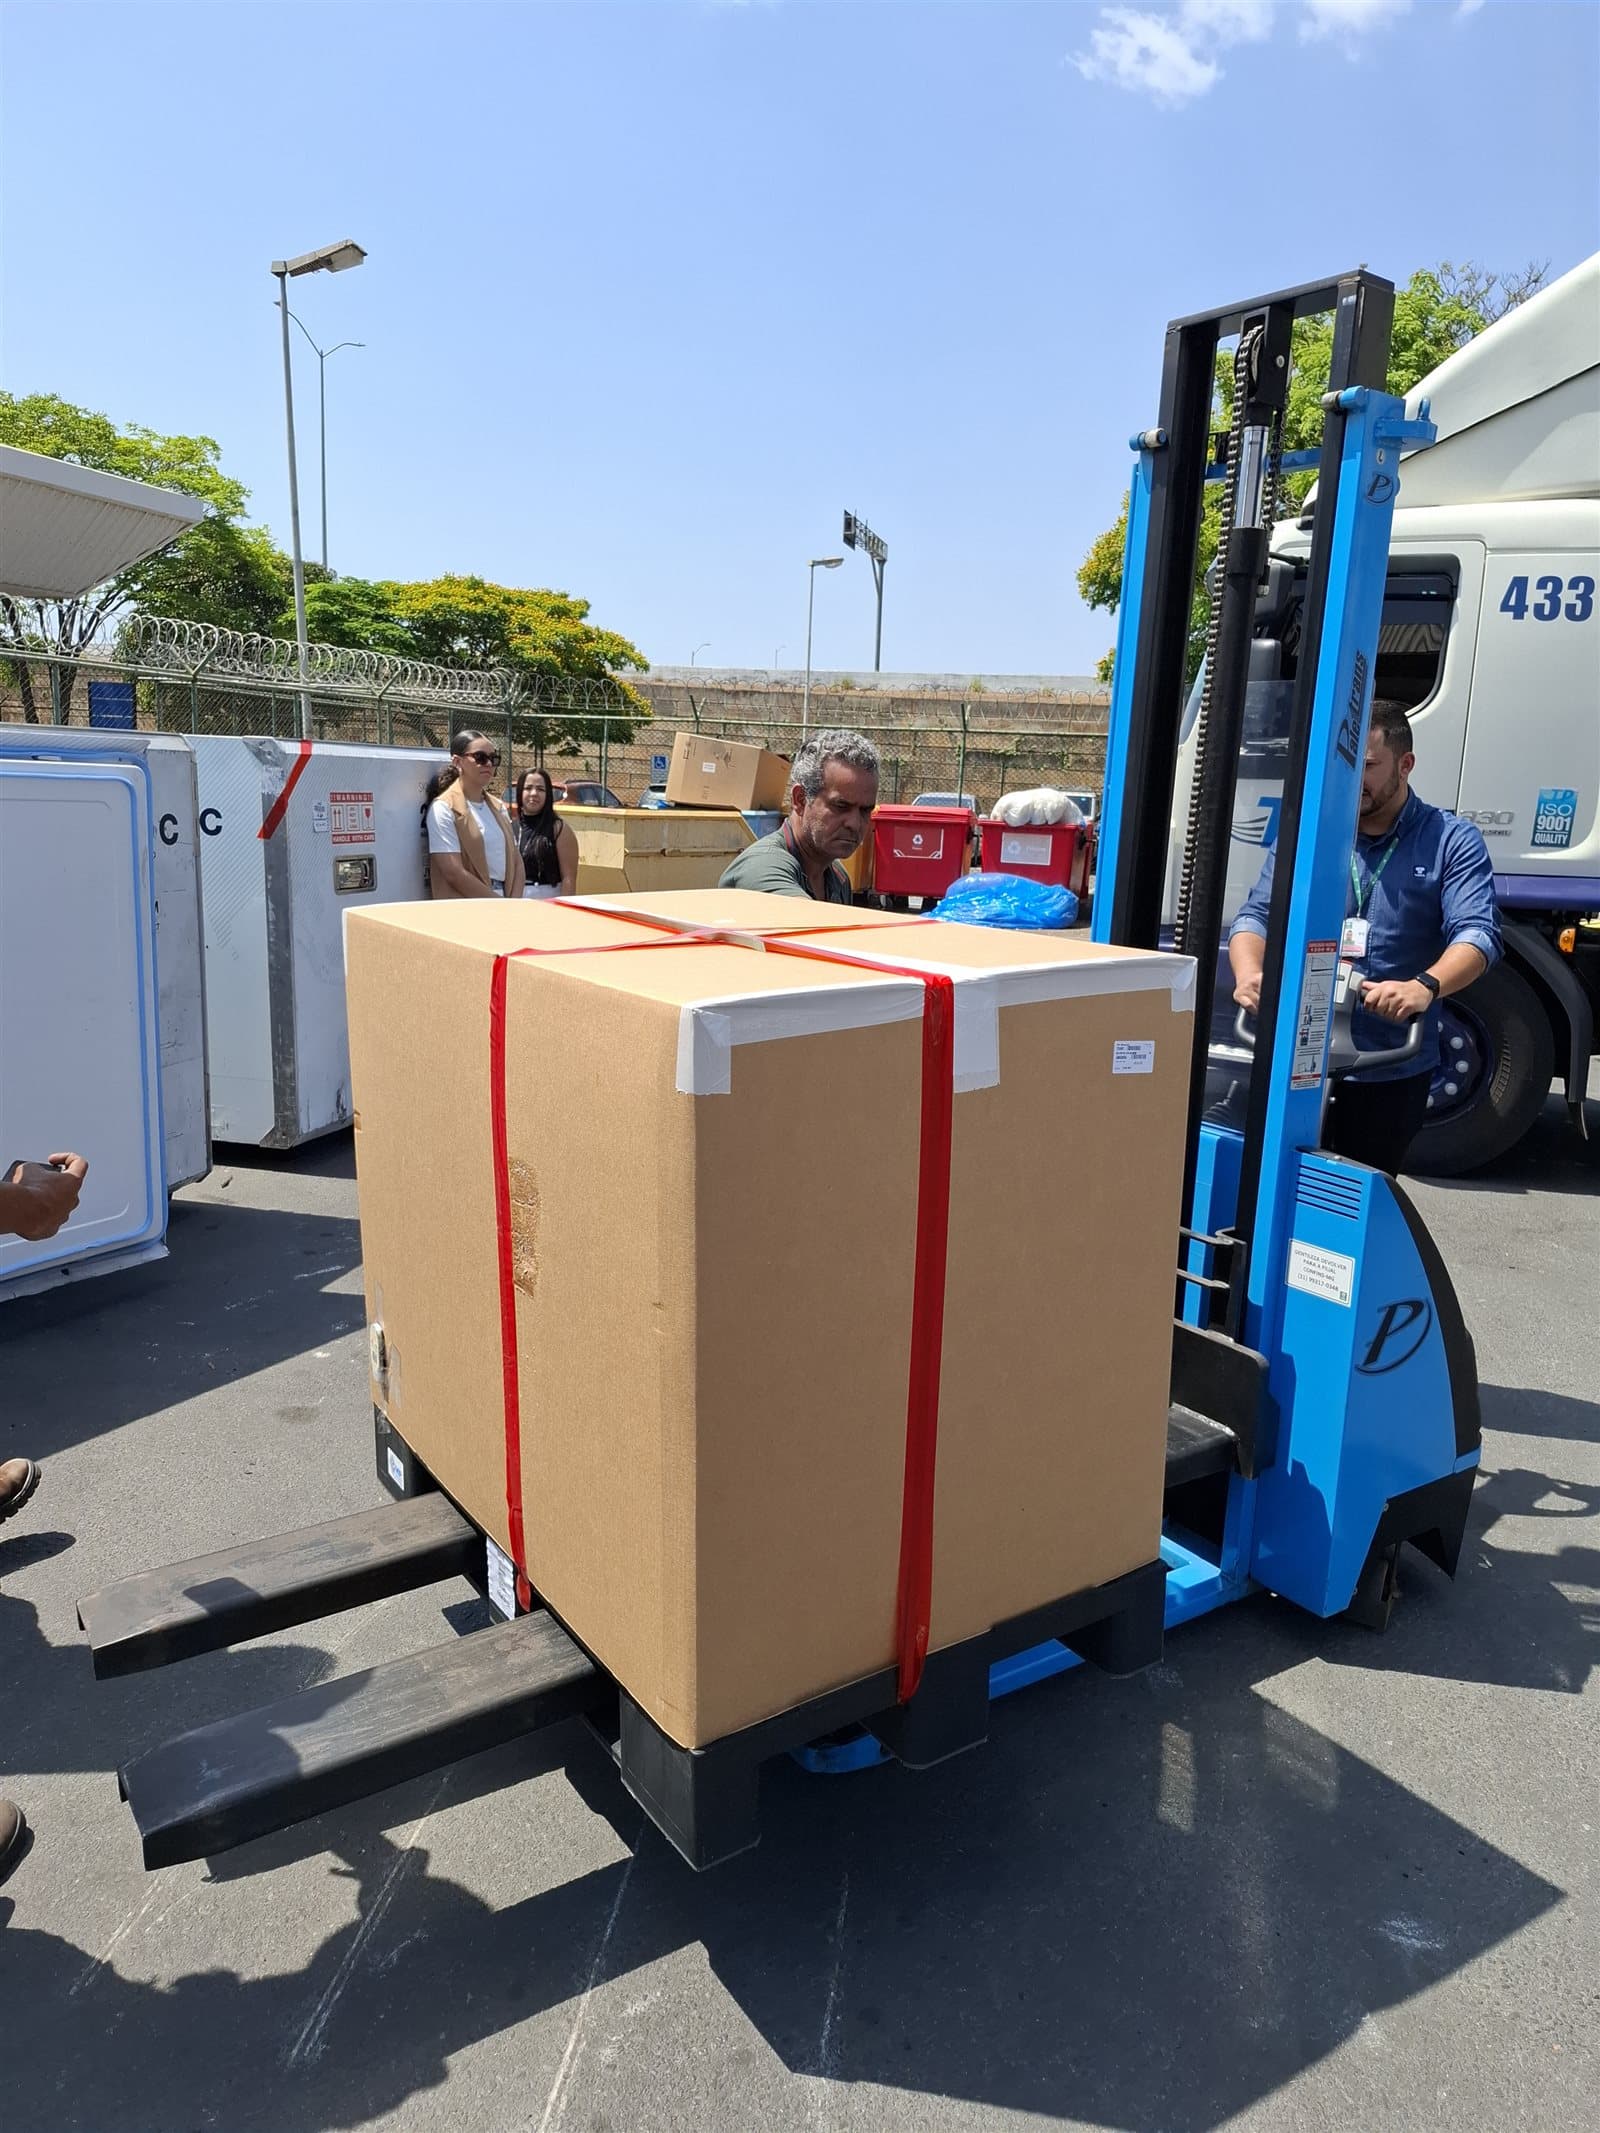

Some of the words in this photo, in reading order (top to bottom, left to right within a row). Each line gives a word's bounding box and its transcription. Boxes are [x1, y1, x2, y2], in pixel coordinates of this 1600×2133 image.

[1499, 575, 1595, 622] 433
[1540, 803, 1573, 817] ISO
[199, 807, 223, 836] C
[1536, 815, 1571, 831] 9001
[159, 813, 179, 846] C
[1534, 833, 1568, 845] QUALITY
[1303, 1259, 1316, 1267] PARA
[1321, 1257, 1346, 1270] DEVOLVER
